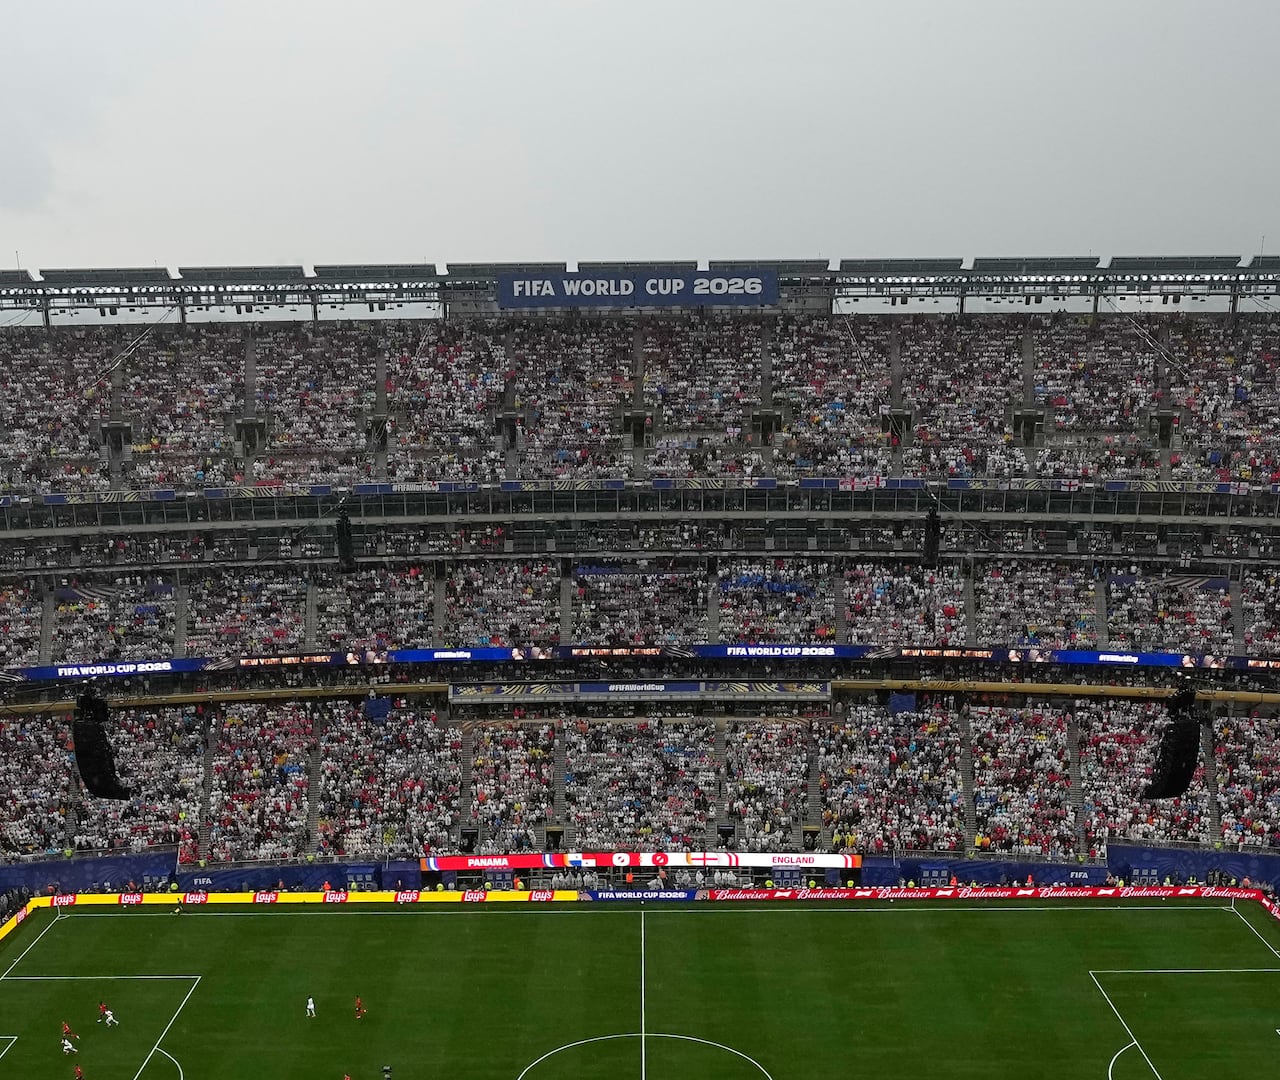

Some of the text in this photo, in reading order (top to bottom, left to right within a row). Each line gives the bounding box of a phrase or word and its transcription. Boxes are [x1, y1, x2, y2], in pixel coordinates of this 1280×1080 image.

[513, 277, 762, 297] FIFA WORLD CUP 2026
[572, 648, 590, 656] NEW
[613, 648, 630, 656] NEW
[727, 647, 835, 656] FIFA WORLD CUP 2026
[902, 649, 920, 657] NEW
[943, 649, 961, 657] NEW
[240, 658, 258, 666] NEW
[1248, 659, 1268, 668] NEW
[58, 662, 172, 676] FIFA WORLD CUP 2026
[609, 683, 665, 692] #FIFAWorldCup
[468, 857, 508, 867] PANAMA
[772, 856, 814, 864] ENGLAND
[1070, 871, 1088, 879] FIFA
[326, 892, 346, 902] Lay's
[398, 891, 418, 902] Lay's
[465, 891, 485, 902] Lay's
[531, 890, 552, 901] Lay's
[643, 891, 658, 899] CUP
[714, 889, 769, 900] Budweiser
[793, 889, 849, 899] Budweiser
[873, 888, 930, 899] Budweiser
[954, 887, 1011, 898] Budweiser
[1034, 887, 1092, 898] Budweiser
[1118, 886, 1173, 897] Budweiser
[1199, 887, 1256, 898] Budweiser
[53, 894, 74, 906] Lay's
[121, 893, 140, 903] Lay's
[186, 893, 206, 903] Lay's
[256, 892, 276, 903] Lay's
